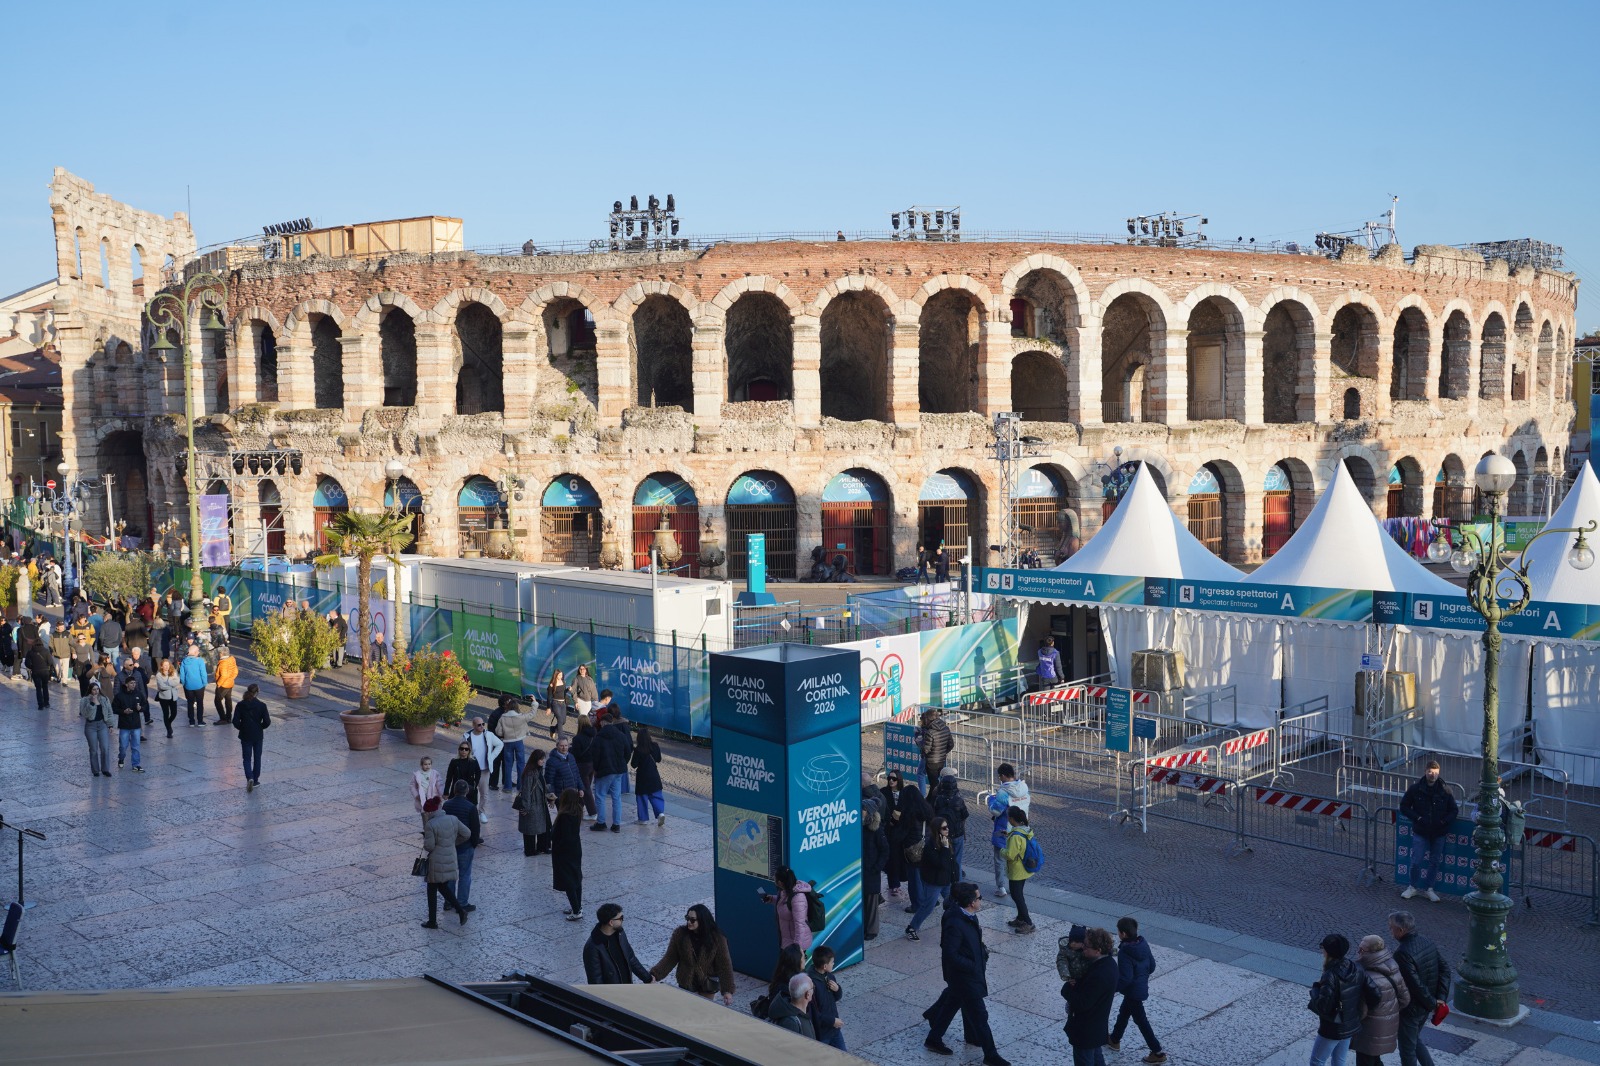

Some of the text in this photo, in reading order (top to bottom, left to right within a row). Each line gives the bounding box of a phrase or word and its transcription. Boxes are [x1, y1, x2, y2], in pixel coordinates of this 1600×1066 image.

[570, 479, 578, 491] 6
[1018, 575, 1082, 586] Ingresso spettatori
[1084, 580, 1096, 596] A
[258, 592, 282, 604] MILANO
[1042, 586, 1065, 594] Entrance
[1200, 586, 1278, 600] Ingresso spettatori
[1200, 598, 1258, 608] Spectator Entrance
[1280, 592, 1295, 610] A
[1440, 602, 1478, 614] Ingress
[1440, 615, 1514, 628] Spectator Ennce
[1543, 610, 1562, 630] A
[464, 628, 498, 646] MILANO
[469, 643, 506, 662] CORTINA
[476, 659, 494, 673] 2026
[611, 656, 660, 676] MILANO
[620, 672, 672, 695] CORTINA
[720, 674, 765, 690] MILANO
[796, 672, 842, 692] MILANO
[630, 690, 654, 708] 2026
[727, 687, 774, 705] CORTINA
[805, 684, 850, 703] CORTINA
[736, 702, 758, 716] 2026
[814, 700, 836, 714] 2026
[725, 752, 766, 770] VERONA
[730, 765, 775, 783] OLYMPIC
[726, 776, 760, 792] ARENA
[798, 798, 847, 824] VERONA
[805, 809, 858, 836] OLYMPIC
[799, 828, 841, 853] ARENA
